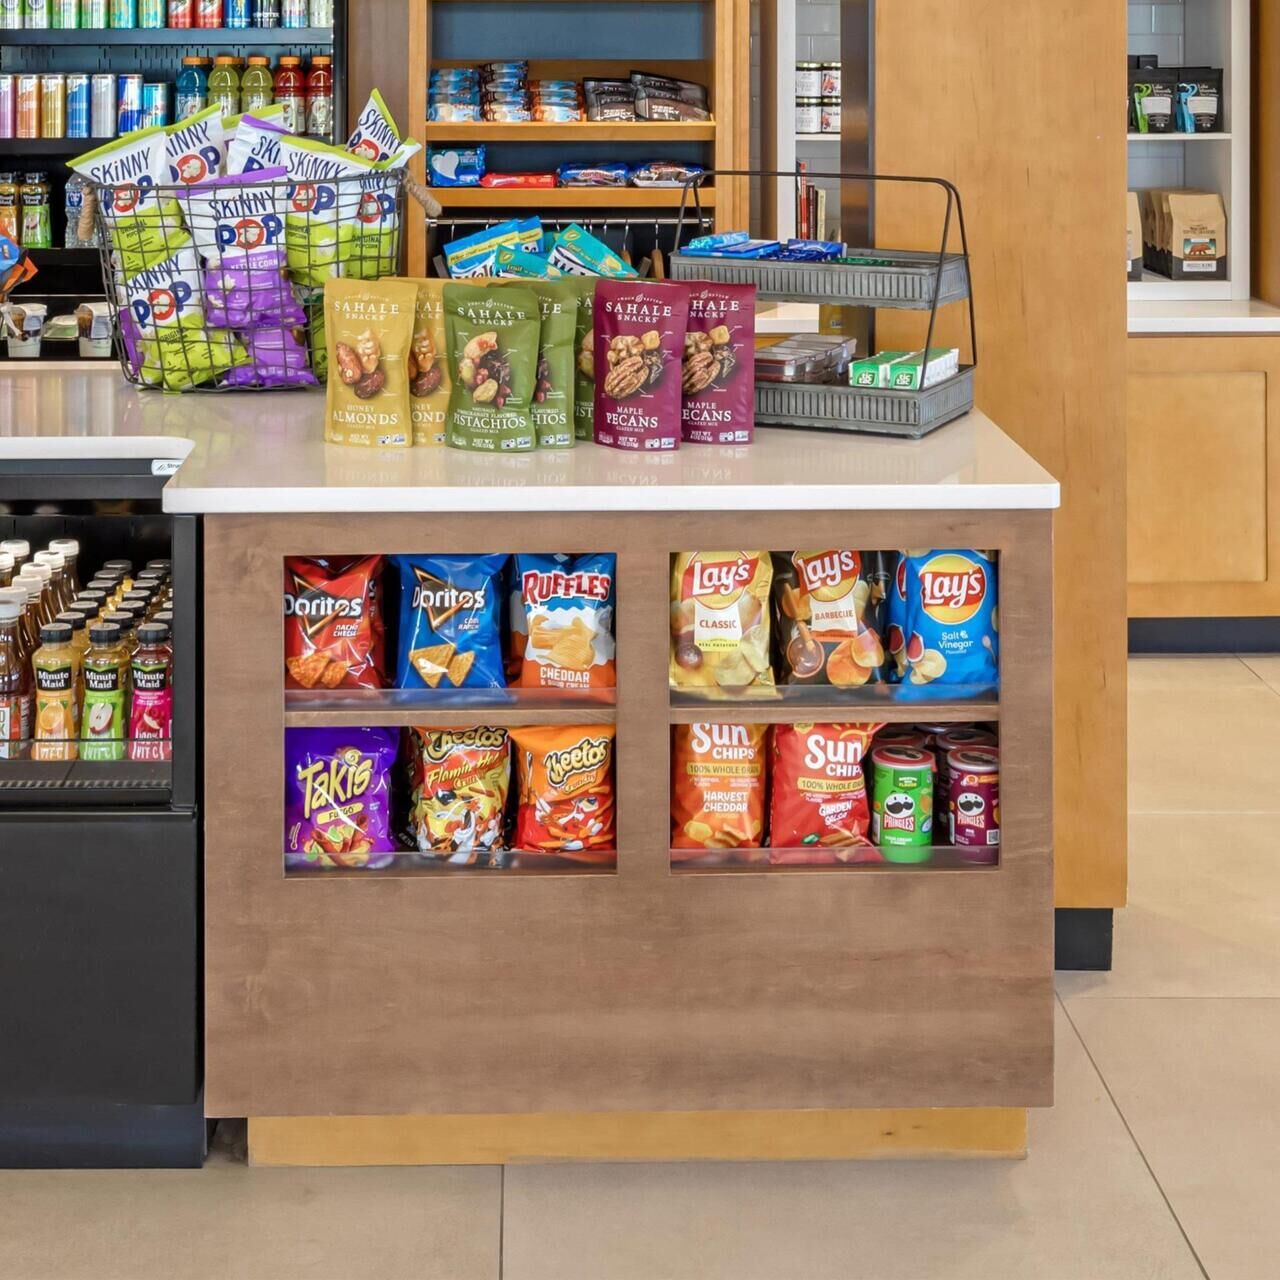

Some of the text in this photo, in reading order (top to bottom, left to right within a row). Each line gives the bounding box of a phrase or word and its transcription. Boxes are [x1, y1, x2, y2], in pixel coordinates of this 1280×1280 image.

[252, 136, 280, 166] SKI
[258, 258, 278, 268] CORN
[334, 301, 399, 314] SAHALE
[605, 301, 672, 316] SAHALE
[692, 300, 739, 311] HALE
[457, 306, 526, 320] SAHALE
[617, 314, 657, 323] SNACKS
[347, 404, 374, 412] HONEY
[616, 406, 643, 414] MAPLE
[333, 410, 399, 424] ALMONDS
[454, 413, 526, 429] PISTACHIOS
[606, 412, 658, 428] PECANS
[682, 409, 732, 421] ECANS
[692, 559, 749, 595] Lay's
[798, 551, 855, 591] Lay's
[523, 569, 611, 605] RUFFLES
[924, 570, 982, 608] Lay's
[412, 586, 485, 608] Doritos
[284, 593, 363, 617] Doritos
[815, 610, 853, 620] BARBECUE
[699, 619, 738, 629] CLASSIC
[941, 630, 968, 640] Salt &
[938, 640, 974, 649] Vinegar
[38, 671, 69, 680] Minute
[86, 671, 116, 680] Minute
[133, 671, 164, 680] Minute
[540, 666, 590, 683] CHEDDAR
[41, 679, 65, 688] Maid
[89, 680, 112, 689] Maid
[137, 679, 160, 688] Maid
[423, 726, 508, 762] Cheetos
[691, 723, 750, 754] Sun
[712, 747, 755, 760] CHIPS
[804, 734, 862, 769] Sun
[545, 738, 609, 785] Cheetos
[689, 764, 712, 773] 100%
[713, 765, 740, 774] WHOLE
[802, 780, 852, 790] 100% WHOLE
[703, 791, 748, 801] HARVEST
[703, 801, 748, 812] CHEDDAR
[819, 800, 853, 816] GARDEN
[884, 814, 914, 831] PRINGLES
[957, 811, 984, 828] PRINGLES
